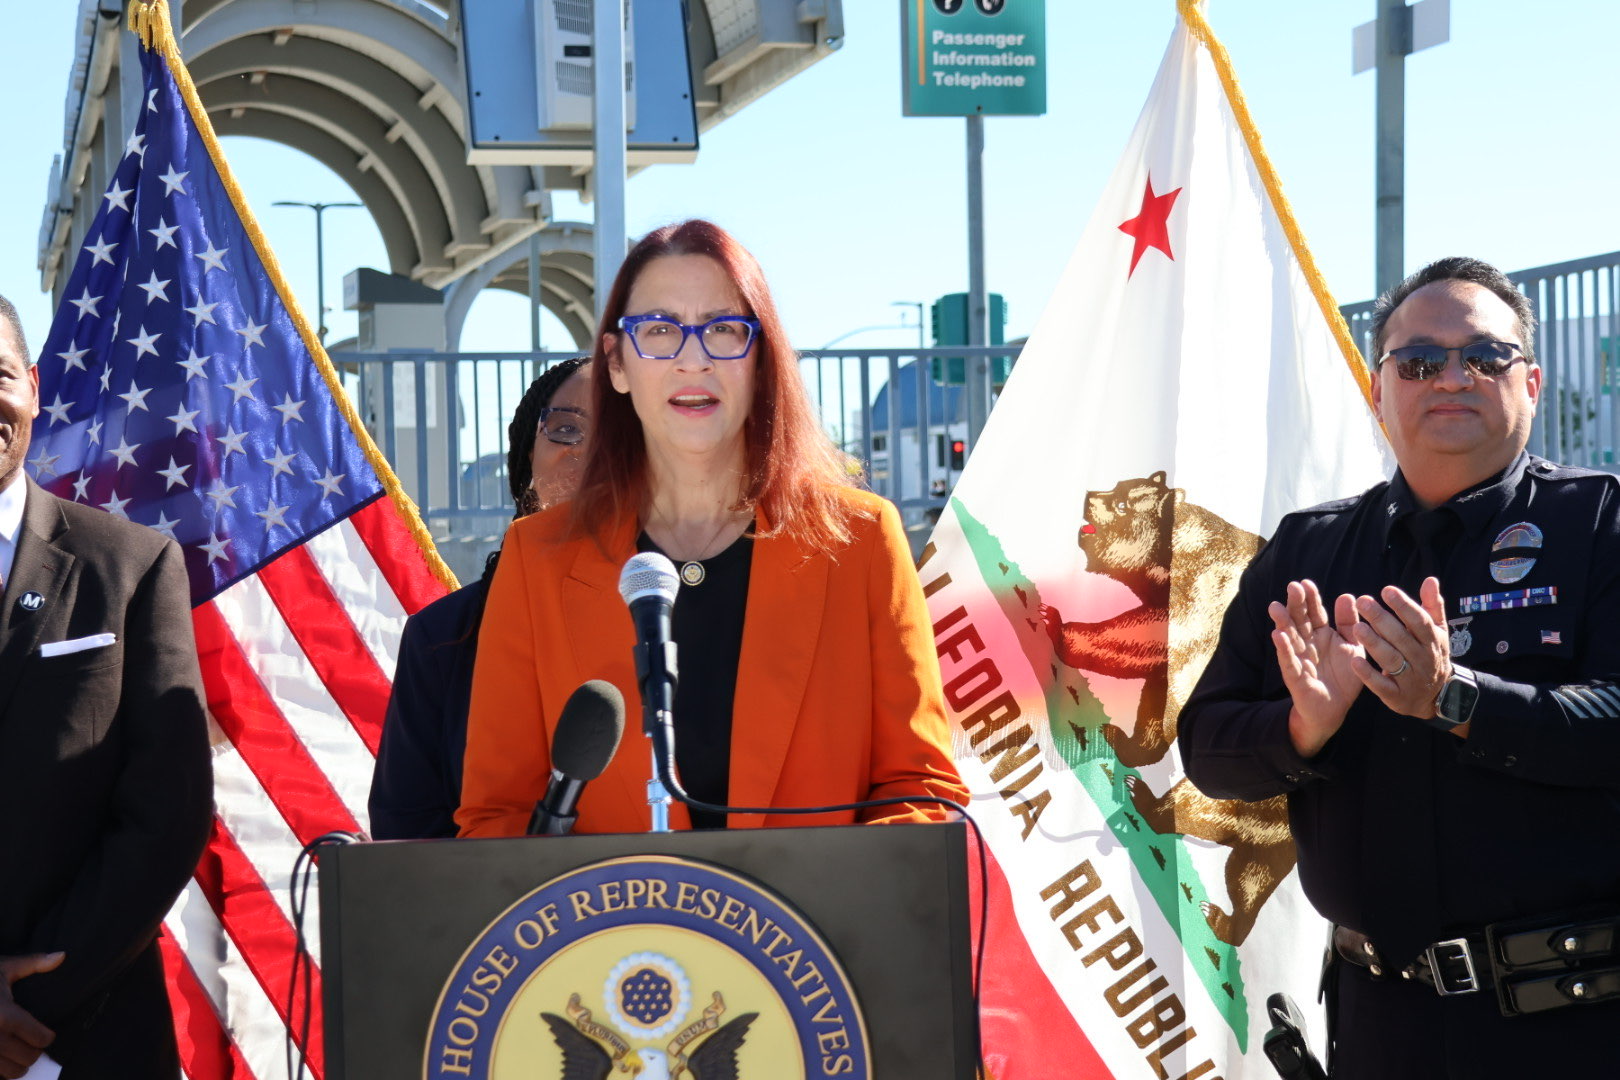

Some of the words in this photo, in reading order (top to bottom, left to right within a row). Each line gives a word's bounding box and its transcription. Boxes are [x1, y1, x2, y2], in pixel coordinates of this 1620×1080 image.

[932, 30, 1025, 48] Passenger
[932, 51, 1036, 66] Information
[932, 71, 1025, 89] Telephone
[23, 593, 41, 608] M
[441, 945, 519, 1076] HOUSE
[514, 903, 562, 950] OF
[568, 879, 854, 1077] REPRESENTATIVES
[1039, 858, 1224, 1080] REPUBLI
